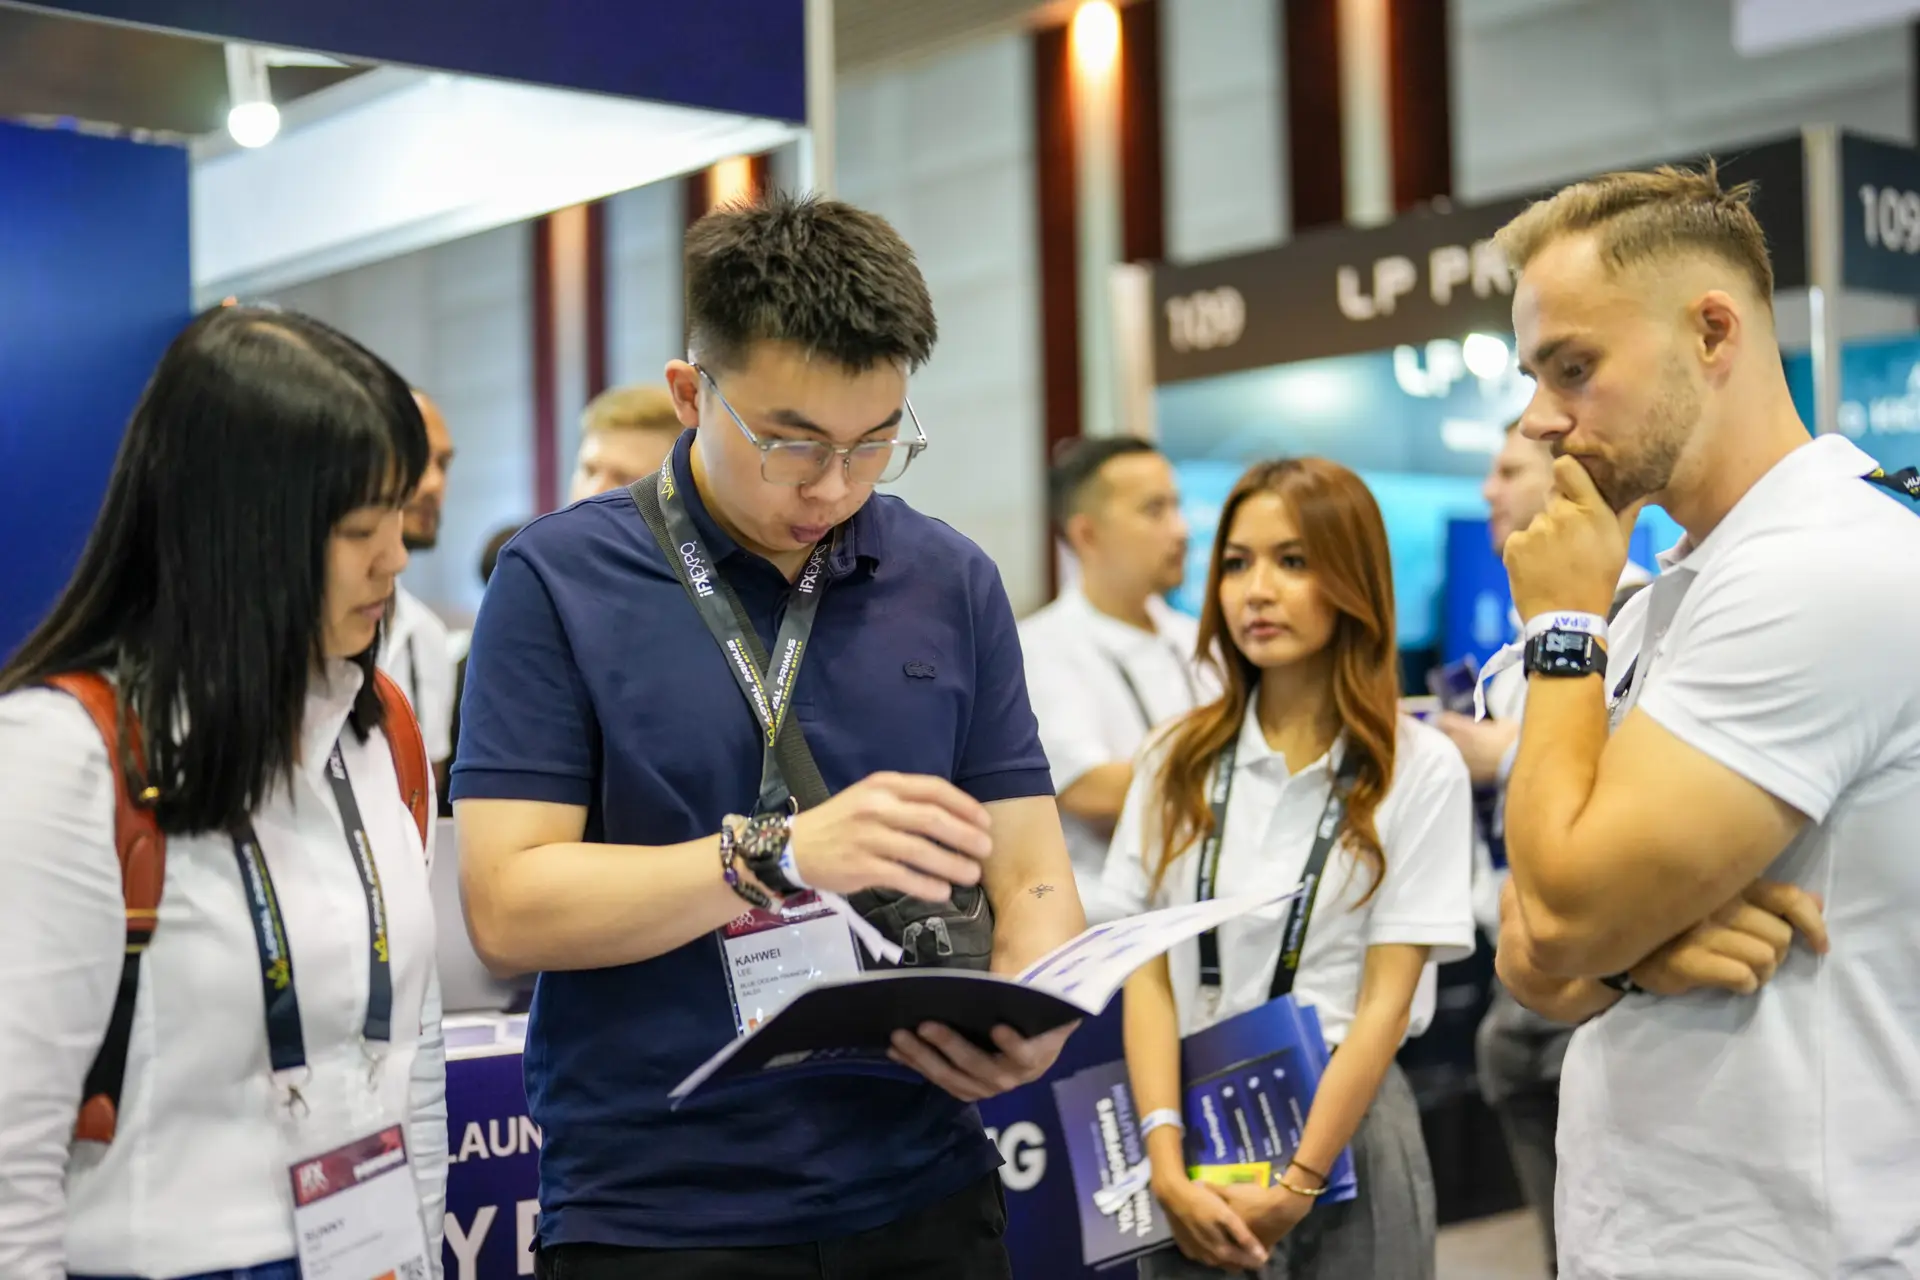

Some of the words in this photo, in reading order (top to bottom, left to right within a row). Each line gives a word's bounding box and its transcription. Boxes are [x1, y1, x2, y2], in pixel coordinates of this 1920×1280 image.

[1859, 184, 1920, 254] 109
[1337, 256, 1417, 321] LP
[726, 639, 754, 683] PRIMUS
[735, 638, 750, 663] BETTER
[776, 638, 797, 686] PRIMUS
[782, 670, 794, 700] TRADING
[791, 640, 803, 668] BETTER
[748, 664, 764, 693] TRADING
[751, 684, 771, 723] LOYAL
[735, 948, 782, 966] KAHWEI
